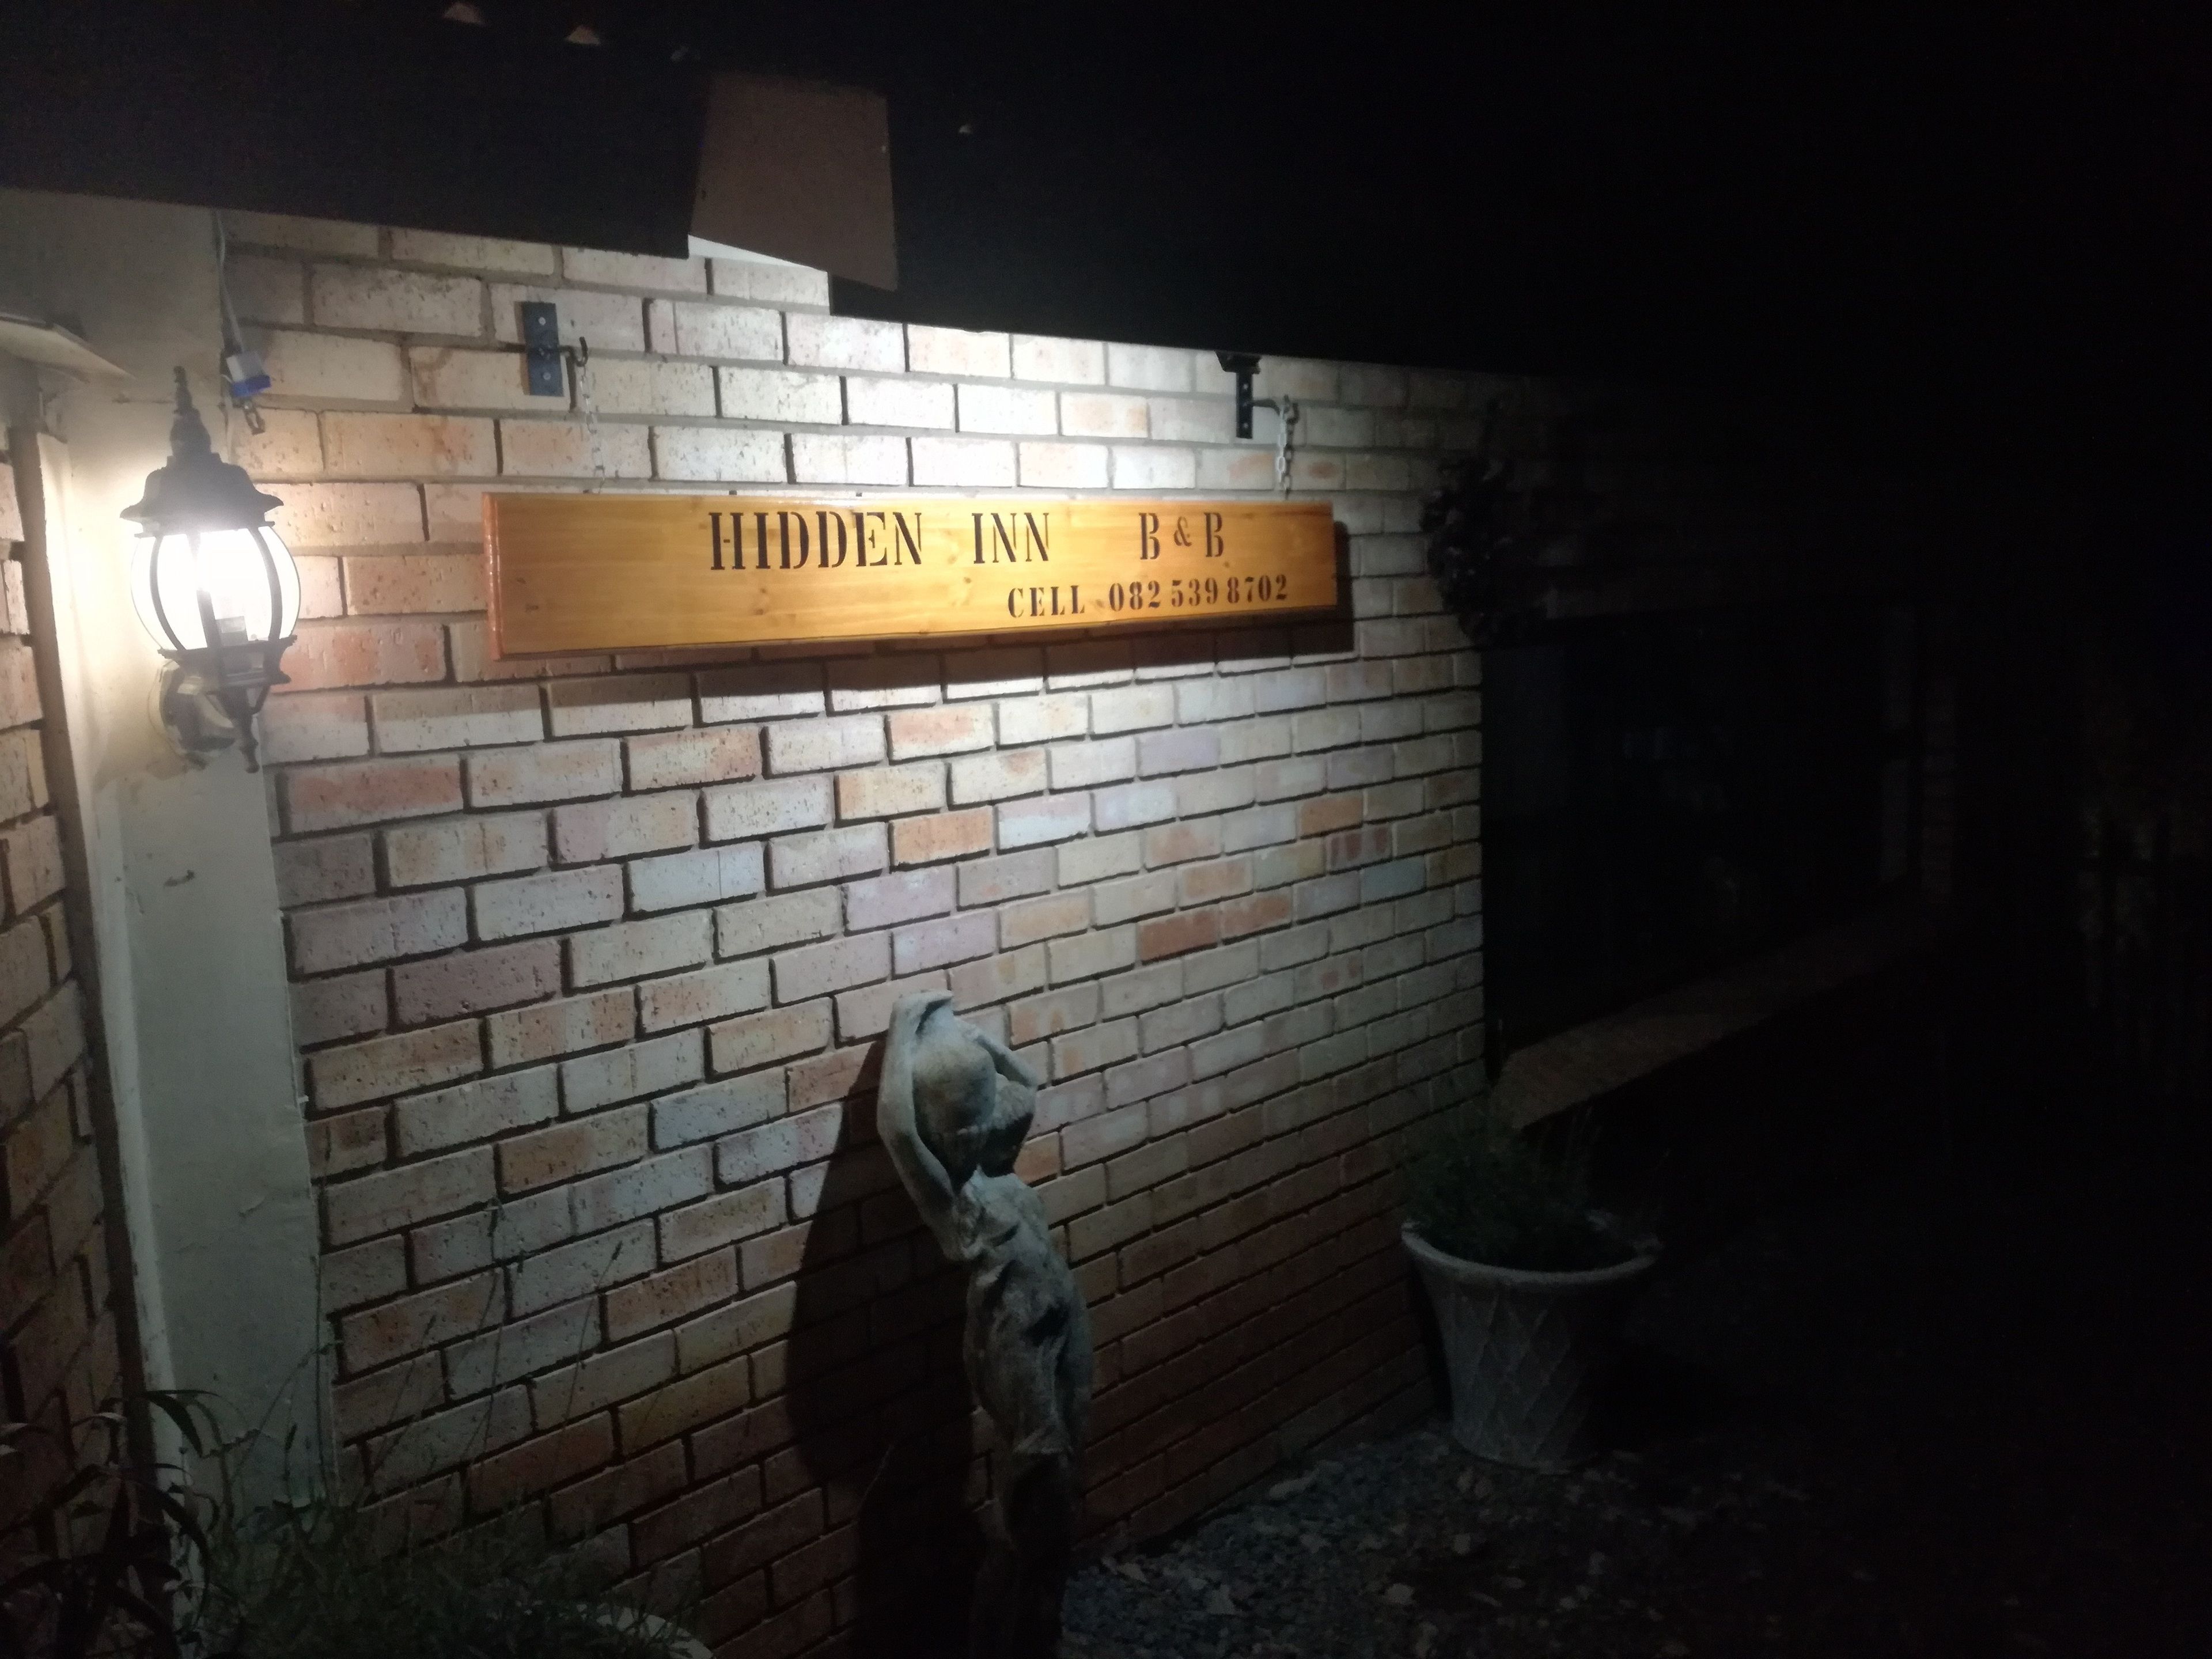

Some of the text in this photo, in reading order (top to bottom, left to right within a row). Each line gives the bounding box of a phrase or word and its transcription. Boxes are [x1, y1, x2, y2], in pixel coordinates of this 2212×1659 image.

[709, 511, 922, 570] HIDDEN
[972, 512, 1049, 563] INN
[1007, 584, 1085, 618] CELL
